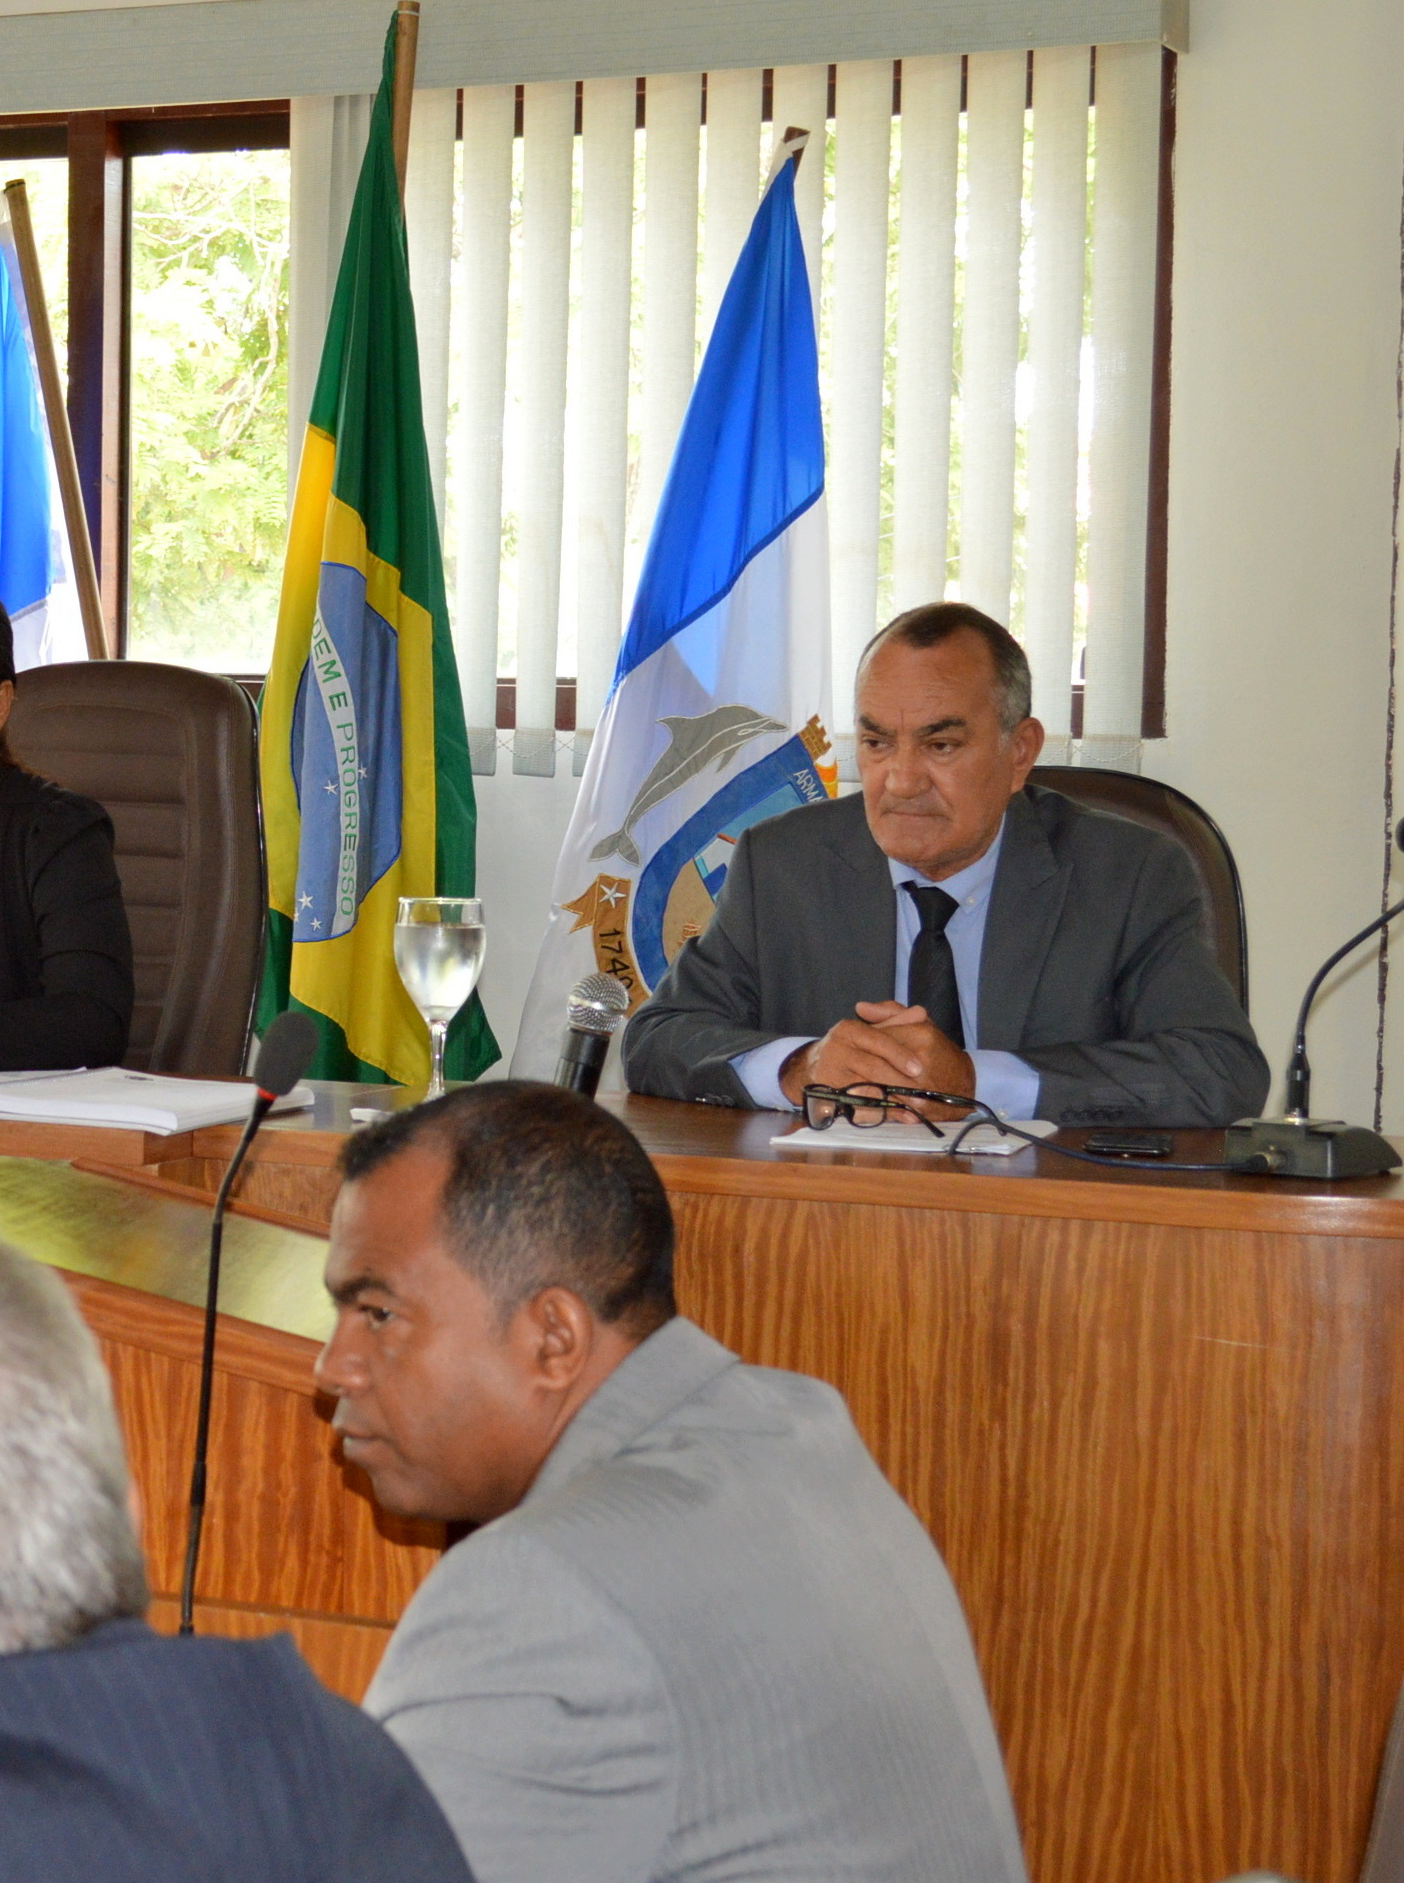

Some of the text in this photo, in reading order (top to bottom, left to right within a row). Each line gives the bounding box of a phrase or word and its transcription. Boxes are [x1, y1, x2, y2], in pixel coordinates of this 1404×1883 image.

[328, 691, 348, 711] E
[793, 769, 824, 803] ARM
[335, 722, 360, 917] PROGRESSO
